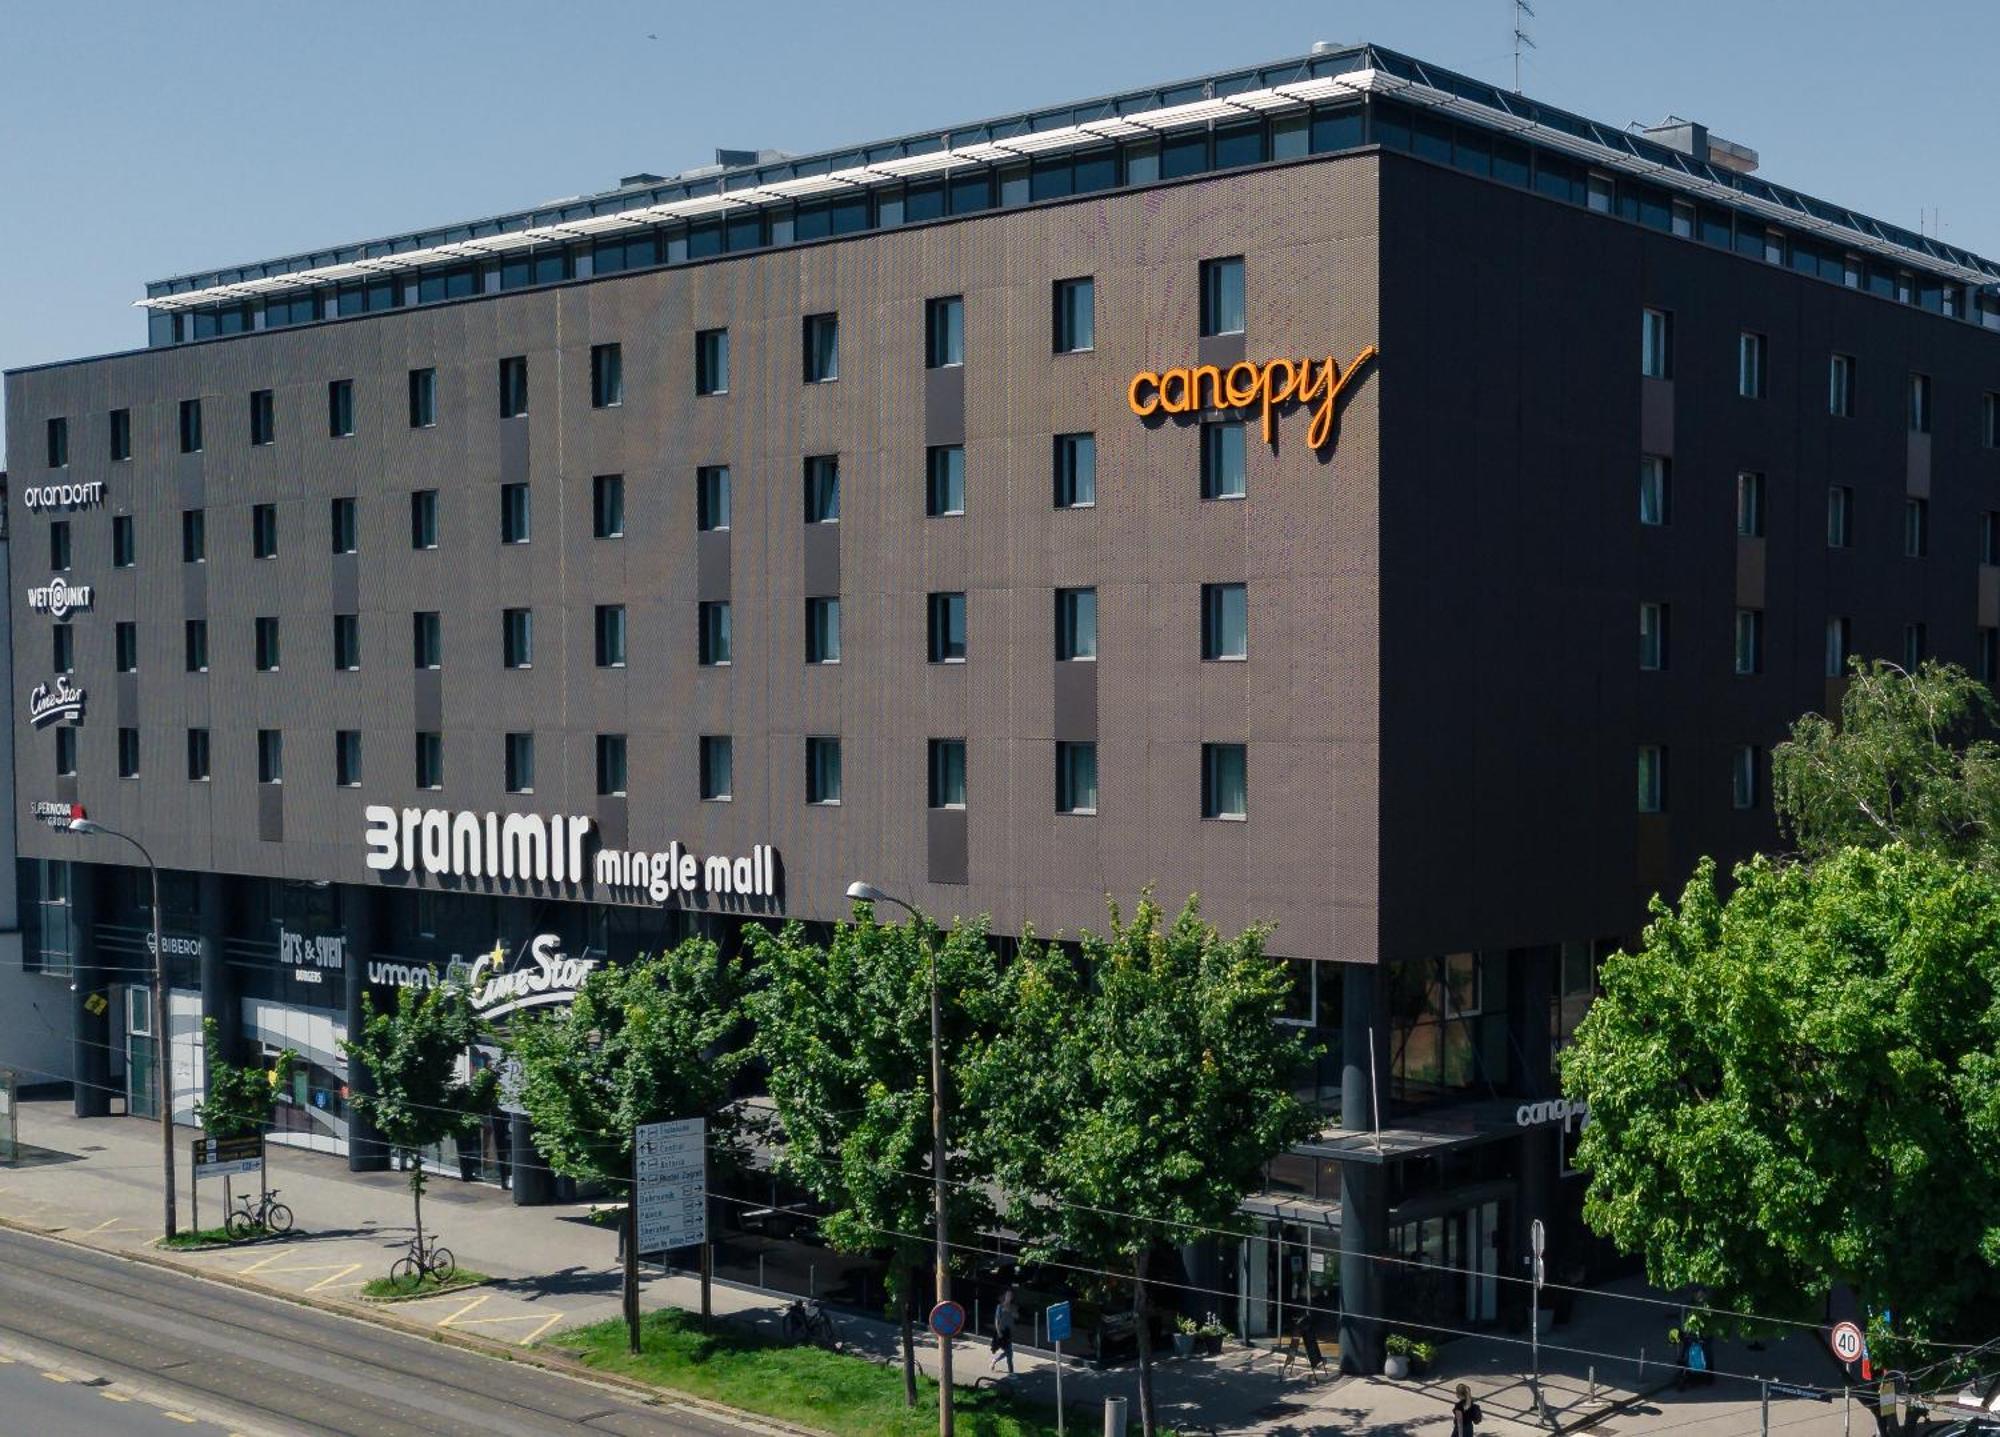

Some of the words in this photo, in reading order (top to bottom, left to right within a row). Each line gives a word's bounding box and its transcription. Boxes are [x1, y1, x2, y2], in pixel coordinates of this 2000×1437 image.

[1127, 344, 1378, 450] canopy
[595, 840, 697, 902] mingle
[704, 844, 774, 896] mall
[1838, 1333, 1856, 1353] 40
